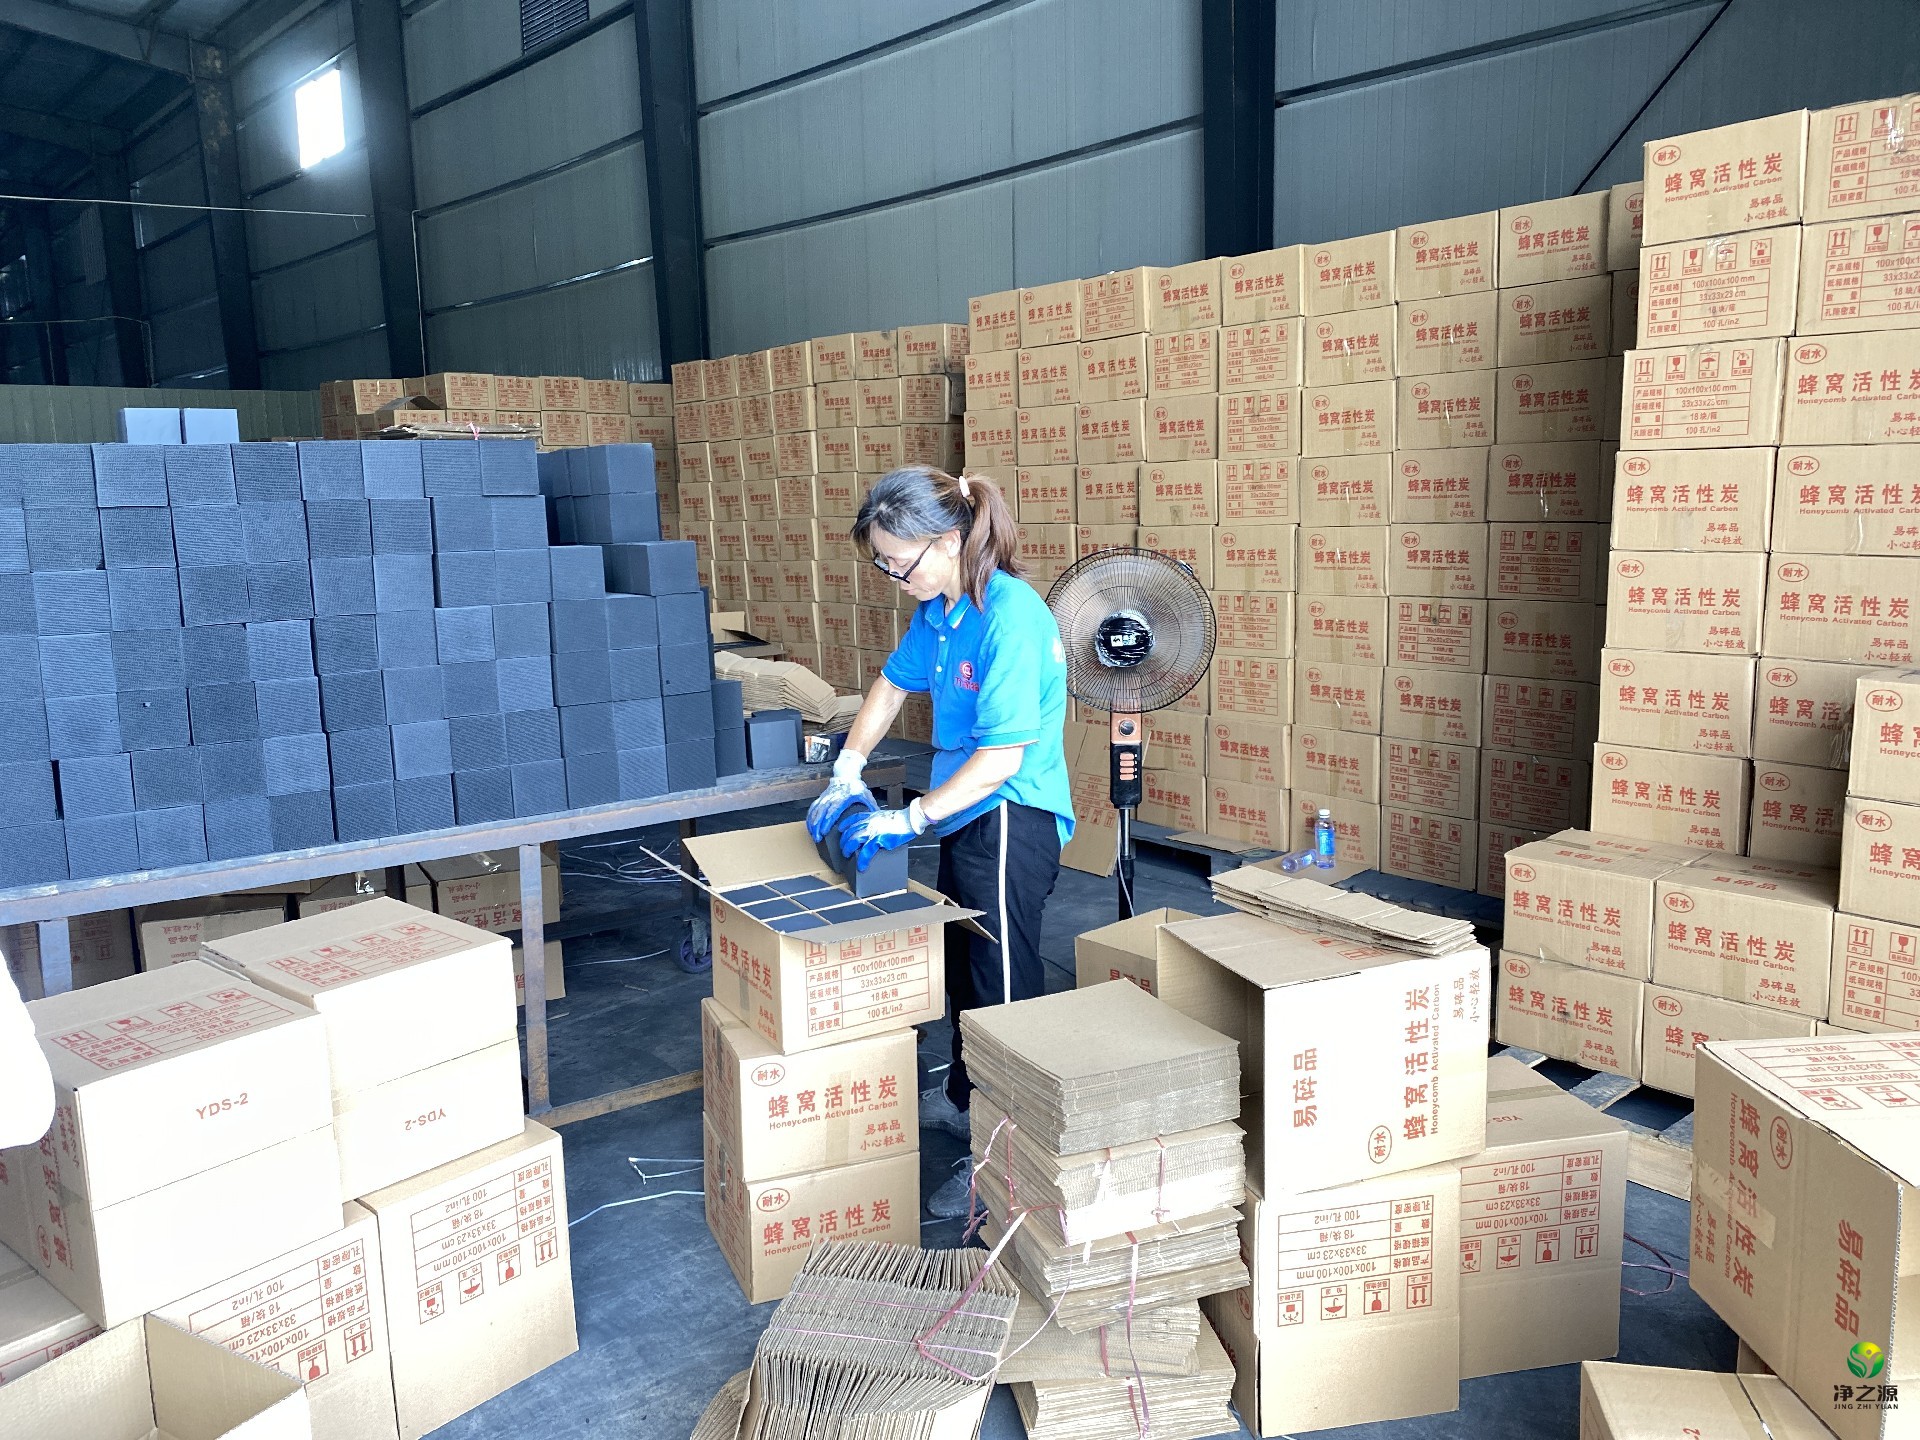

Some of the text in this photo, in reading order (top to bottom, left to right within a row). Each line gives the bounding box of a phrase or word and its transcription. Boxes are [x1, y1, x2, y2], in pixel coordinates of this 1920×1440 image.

[1657, 150, 1677, 162] 耐水
[1664, 152, 1783, 194] 蜂窝活性炭
[1749, 194, 1783, 208] 易碎品
[1744, 206, 1789, 222] 小心轻放
[1514, 219, 1531, 232] 耐水
[1518, 225, 1591, 251] 蜂窝活性炭
[1415, 241, 1479, 264] 蜂窝活性炭
[1320, 260, 1376, 283] 蜂窝活性炭
[1234, 272, 1285, 294] 蜂窝活性炭
[1692, 275, 1739, 289] 100x100x100
[1519, 306, 1591, 329] 蜂窝活性炭
[1800, 349, 1821, 360] 耐水
[1088, 356, 1138, 374] 蜂窝活性炭
[1675, 384, 1720, 395] 100x100x100
[1797, 396, 1847, 405] Honeycomb
[1158, 418, 1205, 435] 蜂窝活性炭
[1628, 461, 1646, 472] 耐水
[1792, 461, 1814, 471] 耐水
[1407, 477, 1470, 492] 蜂窝活性炭
[1626, 483, 1739, 504] 蜂窝活性炭
[1706, 523, 1739, 532] 易碎品
[1700, 536, 1743, 545] 小心轻放
[1621, 564, 1640, 574] 耐水
[1783, 568, 1804, 578] 耐水
[1628, 586, 1741, 608] 蜂窝活性炭
[1780, 591, 1910, 619] 蜂窝活性炭
[1779, 613, 1908, 628] Honeycomb Activated Carbon
[1708, 626, 1741, 636] 易碎品
[1504, 631, 1572, 649] 蜂窝活性炭
[1703, 638, 1746, 649] 小心轻放
[1870, 638, 1909, 649] 易碎品
[1864, 651, 1913, 663] 小心轻放
[1612, 662, 1631, 673] 耐水
[1771, 672, 1793, 683] 耐水
[1400, 692, 1462, 712] 蜂窝活性炭
[1619, 685, 1730, 711] 蜂窝活性炭
[1872, 695, 1897, 707] 耐水
[1769, 717, 1816, 729] Honeycomb
[1219, 739, 1270, 759] 蜂窝活性炭
[1693, 740, 1735, 752] 小心轻放
[1605, 756, 1624, 767] 耐水
[1611, 778, 1721, 810] 蜂窝活性炭
[1861, 814, 1886, 828] 耐水
[1688, 825, 1721, 837] 易碎品
[1684, 837, 1726, 850] 小心轻放
[1514, 867, 1532, 878] 耐水
[1513, 890, 1621, 928] 蜂窝活性炭
[1668, 896, 1690, 909] 耐水
[1591, 942, 1621, 956] 易碎品
[1668, 921, 1795, 963] 蜂窝活性炭
[900, 955, 914, 963] mm
[1586, 954, 1626, 970] 小心轻放
[1668, 943, 1795, 972] Honeycomb Activated Carbon
[809, 970, 839, 983] 产品规格
[861, 972, 908, 989] 33x33x23 cm
[809, 985, 840, 1000] 纸箱规格
[871, 993, 880, 1001] 18
[1453, 978, 1465, 1020] 易碎品
[1469, 967, 1481, 1022] 小心轻放
[1752, 991, 1800, 1008] 小心轻放
[868, 1009, 880, 1018] 100
[1508, 984, 1614, 1027] 蜂窝活性炭
[1658, 1000, 1678, 1012] 耐水
[811, 1018, 841, 1033] 孔隙密度
[1403, 986, 1430, 1140] 蜂窝活性炭
[1431, 984, 1440, 1134] Honeycomb Activated Carbon
[757, 1068, 781, 1082] 耐水
[1293, 1048, 1318, 1128] 易碎品
[768, 1074, 898, 1119] 蜂窝活性炭
[196, 1093, 248, 1120] YDS-2
[405, 1108, 446, 1131] YDS-2
[769, 1100, 898, 1130] Honeycomb Activated Carbon
[865, 1120, 901, 1135] 易碎品
[860, 1132, 906, 1151] 小心轻放
[1374, 1131, 1387, 1158] 耐水
[1776, 1123, 1789, 1160] 耐水
[1493, 1163, 1535, 1176] 100 孔/in2
[1566, 1155, 1600, 1168] 孔隙密度
[472, 1188, 487, 1202] 100
[1497, 1181, 1530, 1194] 18 块/箱
[762, 1193, 785, 1208] 耐水
[1485, 1197, 1540, 1211] 33x33x23 cm
[1564, 1190, 1598, 1202] 纸箱规格
[1732, 1098, 1760, 1298] 蜂窝活性炭
[1394, 1199, 1430, 1215] 孔隙密度
[1563, 1206, 1597, 1220] 产品规格
[520, 1211, 553, 1233] 产品规格
[763, 1199, 891, 1246] 蜂窝活性炭
[1314, 1209, 1361, 1225] 100 孔/in2
[1475, 1213, 1548, 1229] 100x100x100 mm
[441, 1219, 496, 1250] 33x33x23 cm
[862, 1223, 891, 1235] Carbon
[1319, 1229, 1355, 1243] 18 块/箱
[1393, 1236, 1430, 1251] 纸箱规格
[322, 1246, 361, 1271] 孔隙密度
[433, 1232, 507, 1273] 100x100x100 mm
[1307, 1245, 1367, 1261] 33x33x23 cm
[1393, 1254, 1430, 1269] 产品规格
[1296, 1262, 1377, 1280] 100x100x100 mm
[1834, 1219, 1864, 1338] 易碎品
[231, 1279, 285, 1311] 100 孔/in2
[325, 1282, 364, 1308] 纸箱规格
[240, 1301, 281, 1328] 18 块/箱
[326, 1300, 365, 1327] 产品规格
[247, 1314, 297, 1343] 33x33x23
